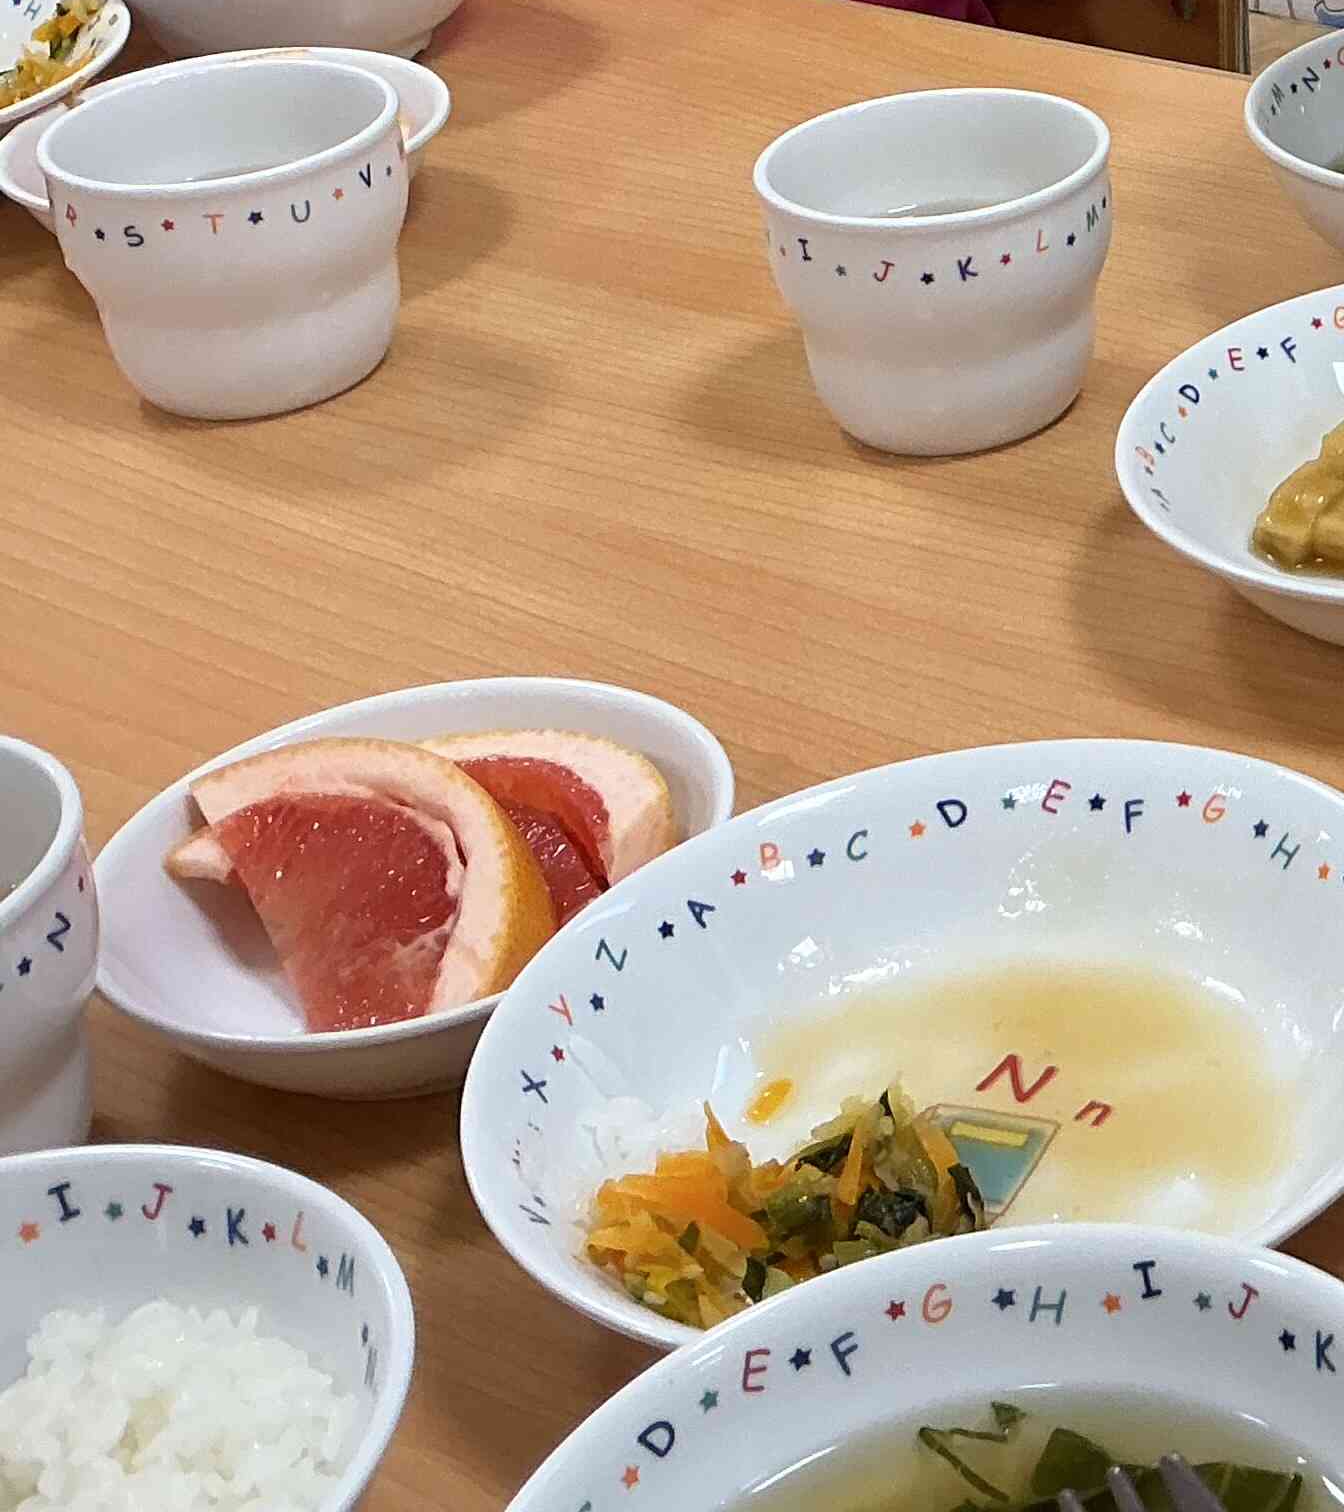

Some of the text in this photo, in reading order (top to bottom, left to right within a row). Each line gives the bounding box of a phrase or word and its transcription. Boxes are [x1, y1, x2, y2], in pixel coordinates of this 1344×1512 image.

[1302, 67, 1320, 93] N
[124, 163, 371, 247] S T U V
[798, 238, 812, 261] I
[874, 261, 895, 282] J
[957, 256, 978, 282] K
[1036, 229, 1049, 254] L
[1179, 384, 1200, 404] D
[1228, 348, 1244, 371] E
[1280, 337, 1296, 363] F
[521, 1070, 548, 1103] X
[549, 994, 573, 1026] Y
[595, 939, 627, 971] Z
[687, 900, 715, 929] A
[760, 843, 781, 870] B
[846, 830, 868, 862] C
[936, 799, 967, 828] D
[1042, 780, 1071, 814] E
[1125, 799, 1144, 833] F
[1203, 794, 1225, 824] G
[1271, 833, 1300, 870] H
[976, 1054, 1112, 1126] N n
[48, 1182, 80, 1222] I
[141, 1183, 173, 1220] J
[227, 1208, 248, 1246] K
[336, 1253, 354, 1296] M
[637, 1421, 675, 1458] D
[742, 1349, 771, 1392] E
[830, 1332, 858, 1376] F
[922, 1284, 952, 1324] G
[1029, 1286, 1066, 1325] H
[1133, 1261, 1162, 1299] I
[1228, 1283, 1258, 1320] J
[1316, 1330, 1336, 1372] K
